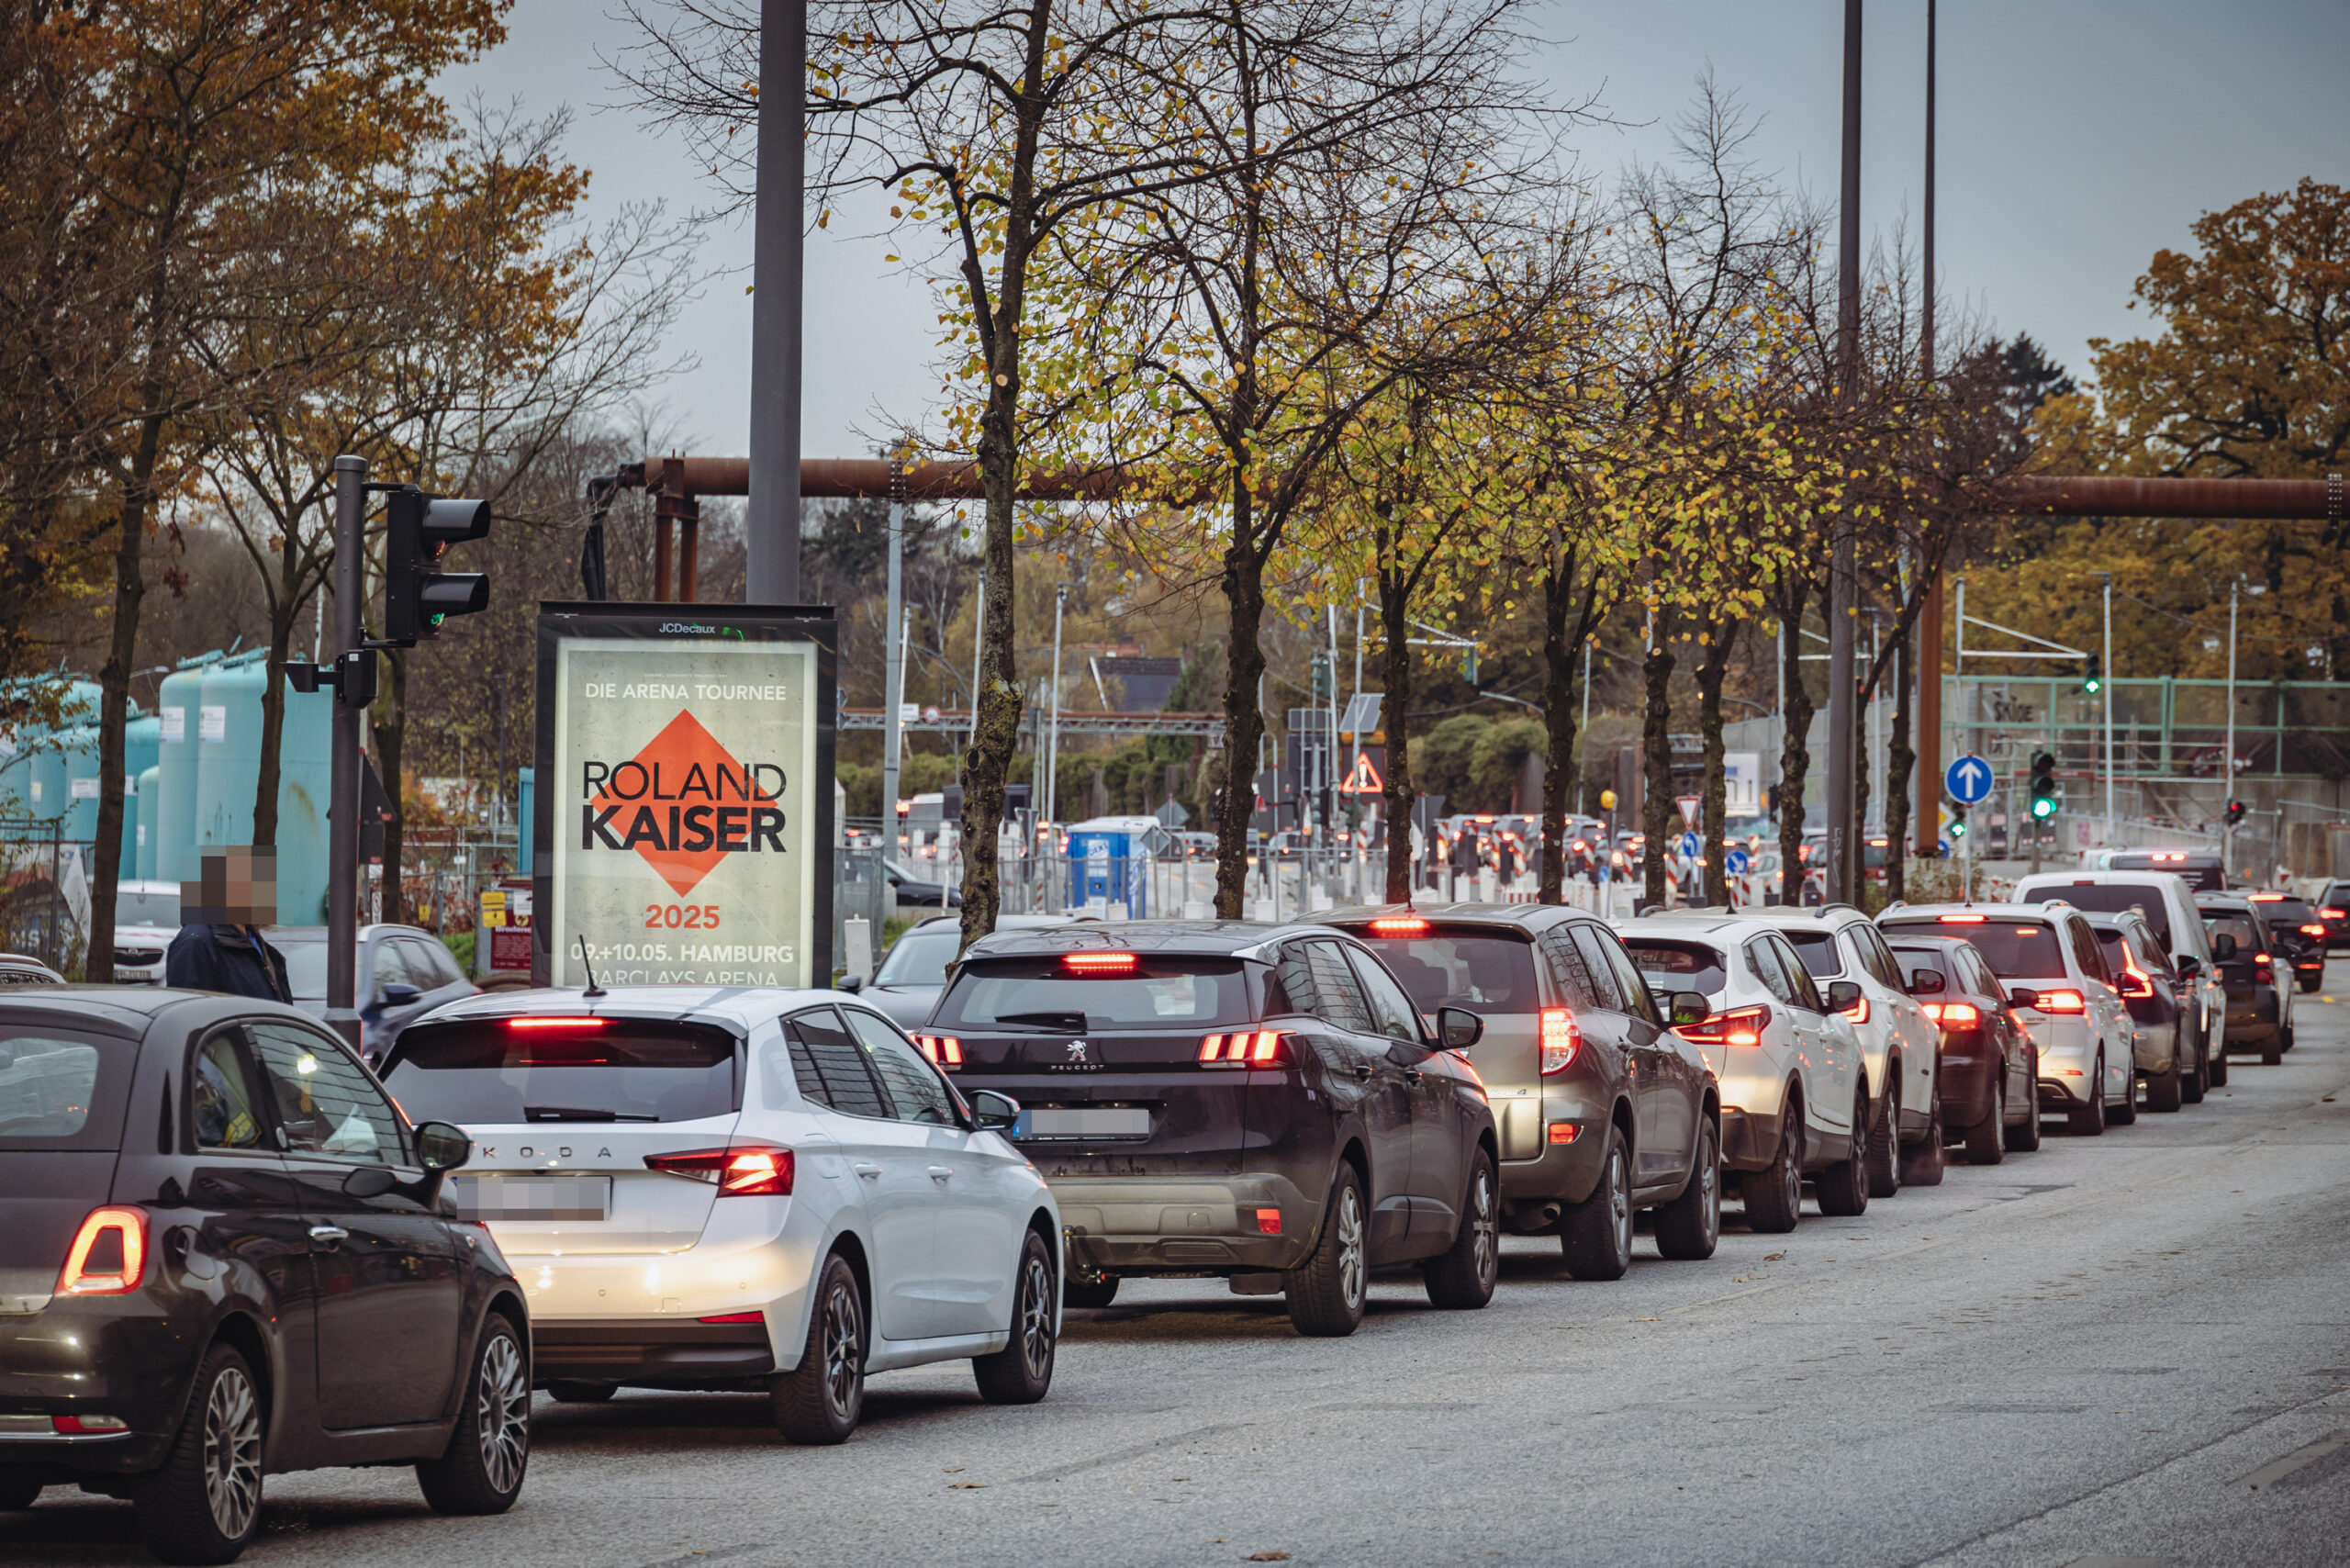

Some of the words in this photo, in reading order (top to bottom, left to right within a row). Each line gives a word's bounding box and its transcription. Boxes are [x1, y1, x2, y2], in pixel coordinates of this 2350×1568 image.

[659, 622, 716, 633] JCDecaux
[586, 683, 617, 698] DIE
[622, 683, 689, 699] ARENA
[695, 685, 787, 700] TOURNEE
[583, 760, 787, 801] ROLAND
[582, 804, 787, 853] KAISER
[645, 904, 721, 929] 2025
[570, 943, 673, 962] 09.+10.05.
[680, 945, 794, 963] HAMBURG
[482, 1147, 611, 1159] KODA
